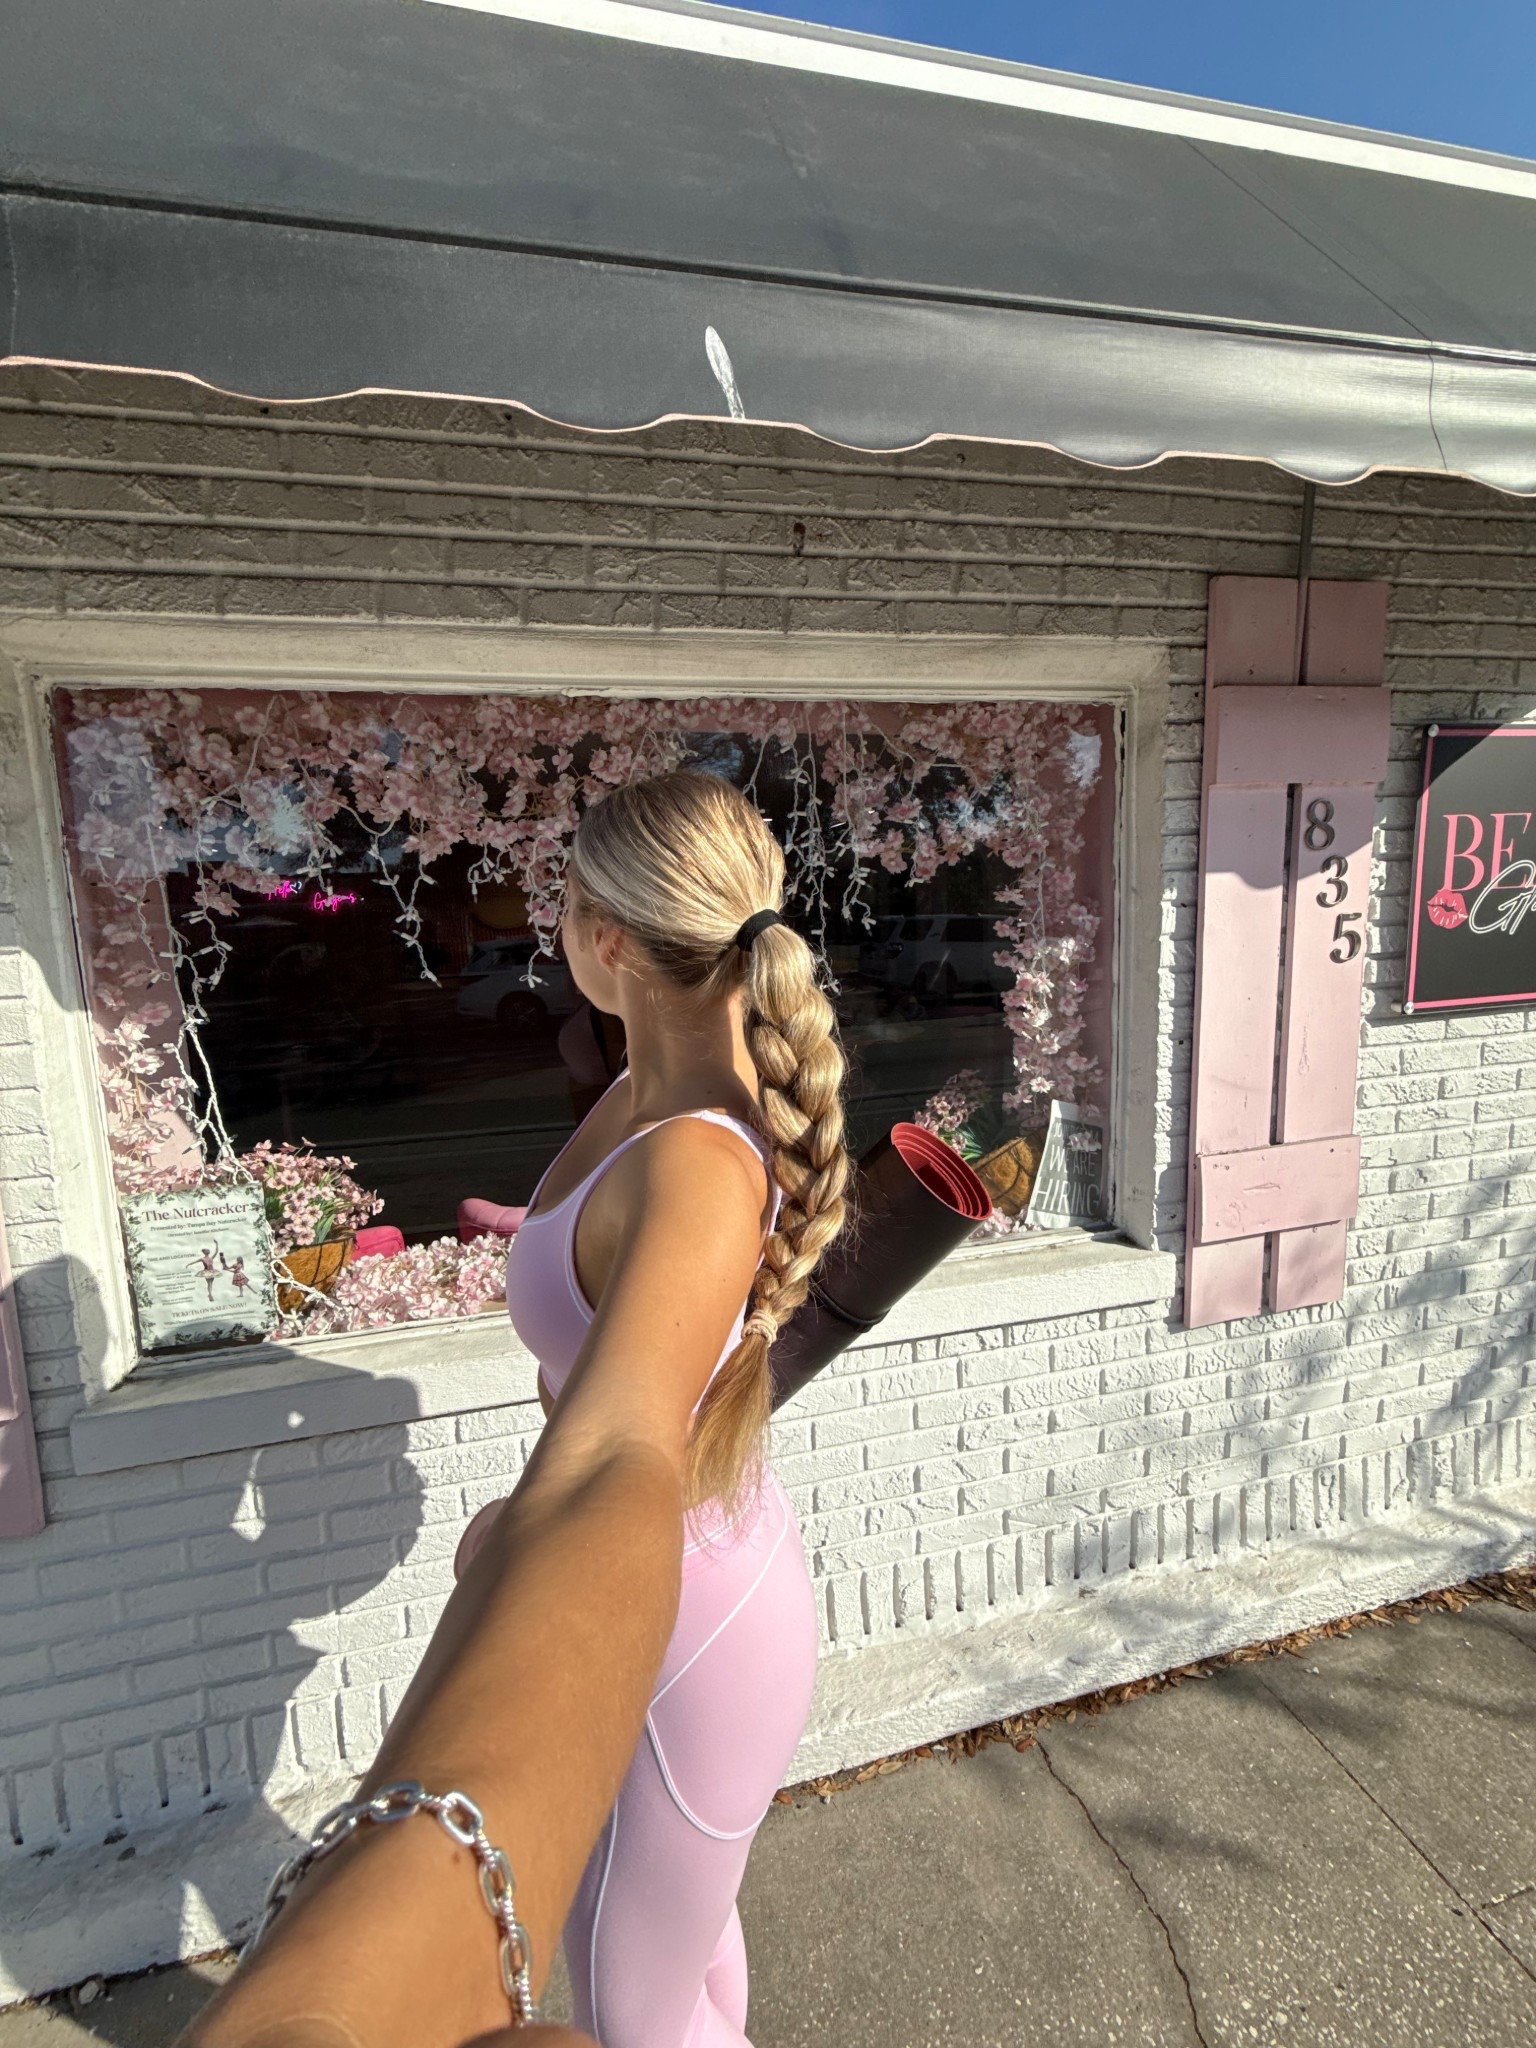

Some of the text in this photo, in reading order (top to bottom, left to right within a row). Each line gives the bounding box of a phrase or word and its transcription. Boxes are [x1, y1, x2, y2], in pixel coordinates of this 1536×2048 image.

[1437, 812, 1536, 893] BE
[1050, 1144, 1071, 1173] WE
[1073, 1150, 1098, 1177] ARE
[1032, 1176, 1099, 1216] HIRING
[142, 1202, 250, 1222] The Nutcracker
[172, 1309, 199, 1318] TICKETS
